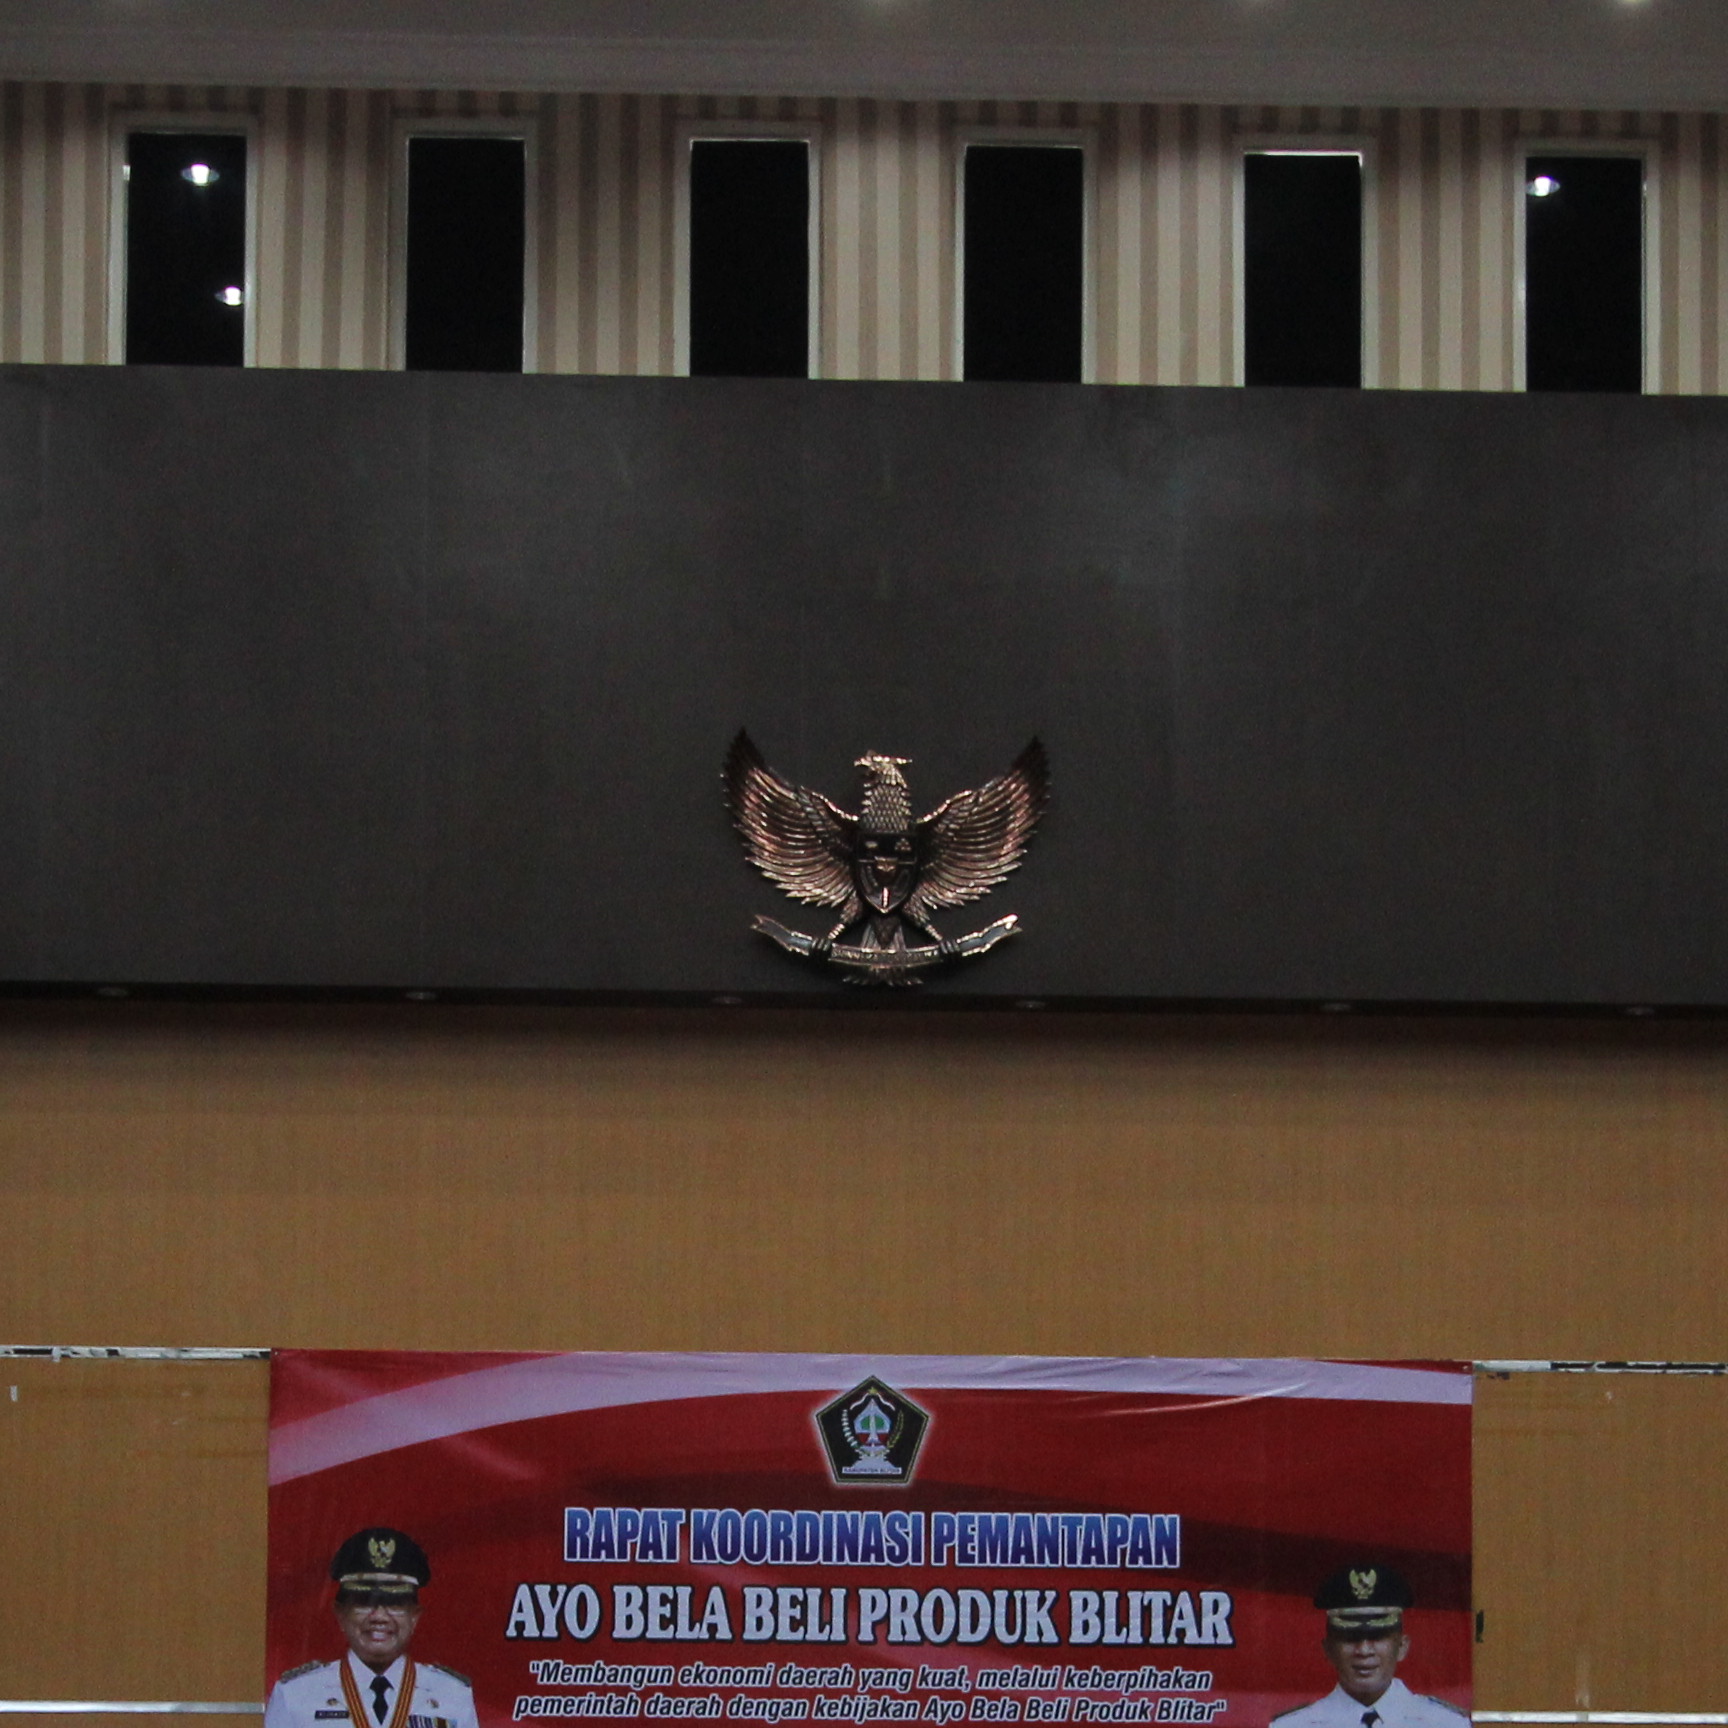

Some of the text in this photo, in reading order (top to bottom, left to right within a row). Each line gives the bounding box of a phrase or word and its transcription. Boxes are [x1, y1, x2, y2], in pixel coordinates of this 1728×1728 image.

[564, 1507, 1181, 1568] RAPAT KOORDINASI PEMANTAPAN
[505, 1583, 1234, 1645] AYO BELA BELI PRODUK BLITAR
[530, 1660, 1212, 1694] "Membangun ekonomi daerah yang kuat, melalui keberpihakan
[513, 1693, 1226, 1725] pemerintah daerah dengan kebijakan Ayo Bela Beli Produk Blitar"
